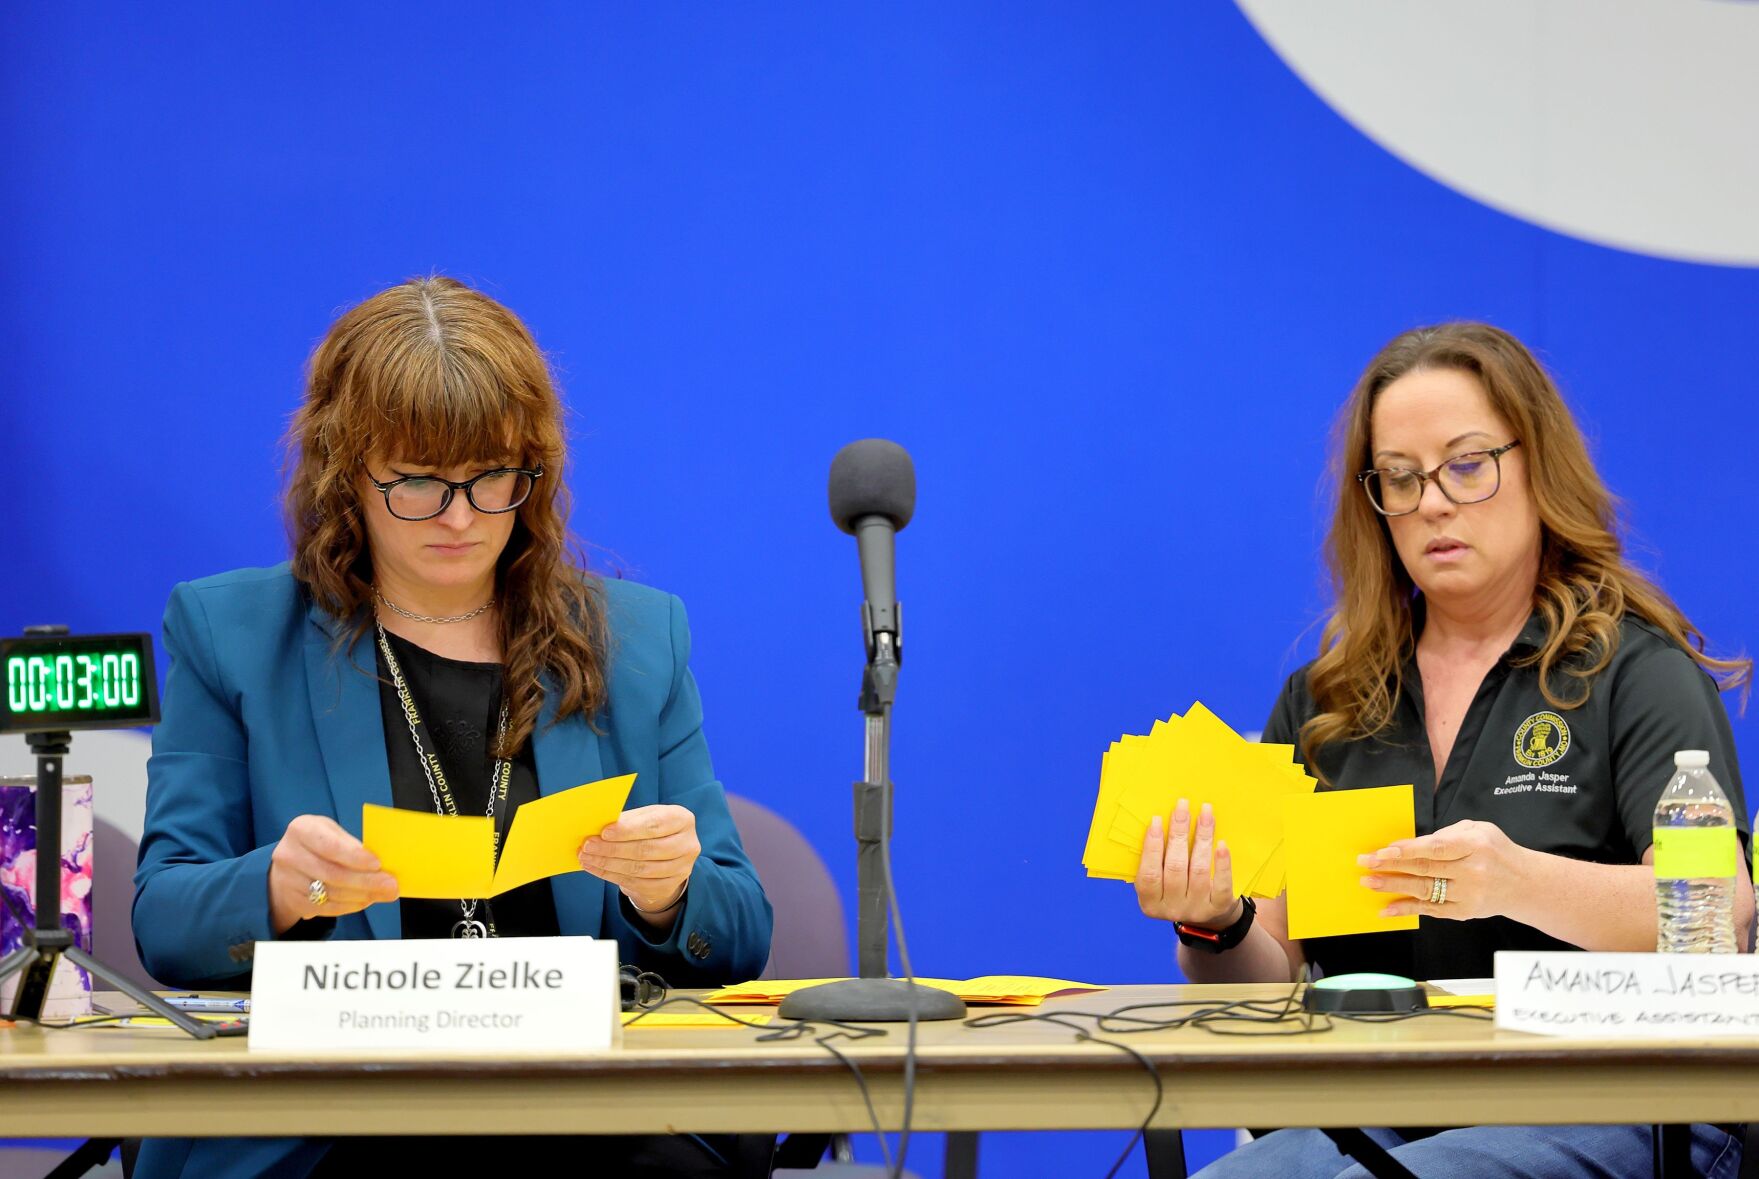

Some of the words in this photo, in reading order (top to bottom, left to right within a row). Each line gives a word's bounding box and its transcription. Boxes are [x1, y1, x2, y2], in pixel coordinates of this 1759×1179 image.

[8, 653, 138, 713] 00:03:00
[398, 675, 421, 725] FRANKLIN
[427, 753, 449, 792] COUNTY
[498, 762, 512, 801] COUNTY
[1505, 772, 1535, 785] Amanda
[1538, 771, 1569, 783] Jasper
[1494, 784, 1532, 795] Executive
[1535, 783, 1577, 794] Assistant
[443, 794, 459, 818] KLIN
[303, 961, 441, 990] Nichole
[454, 961, 564, 989] Zielke
[1524, 960, 1642, 996] AMANDA
[338, 1010, 430, 1032] Planning
[437, 1010, 523, 1029] Director
[1513, 1008, 1625, 1025] EXECUTIVE
